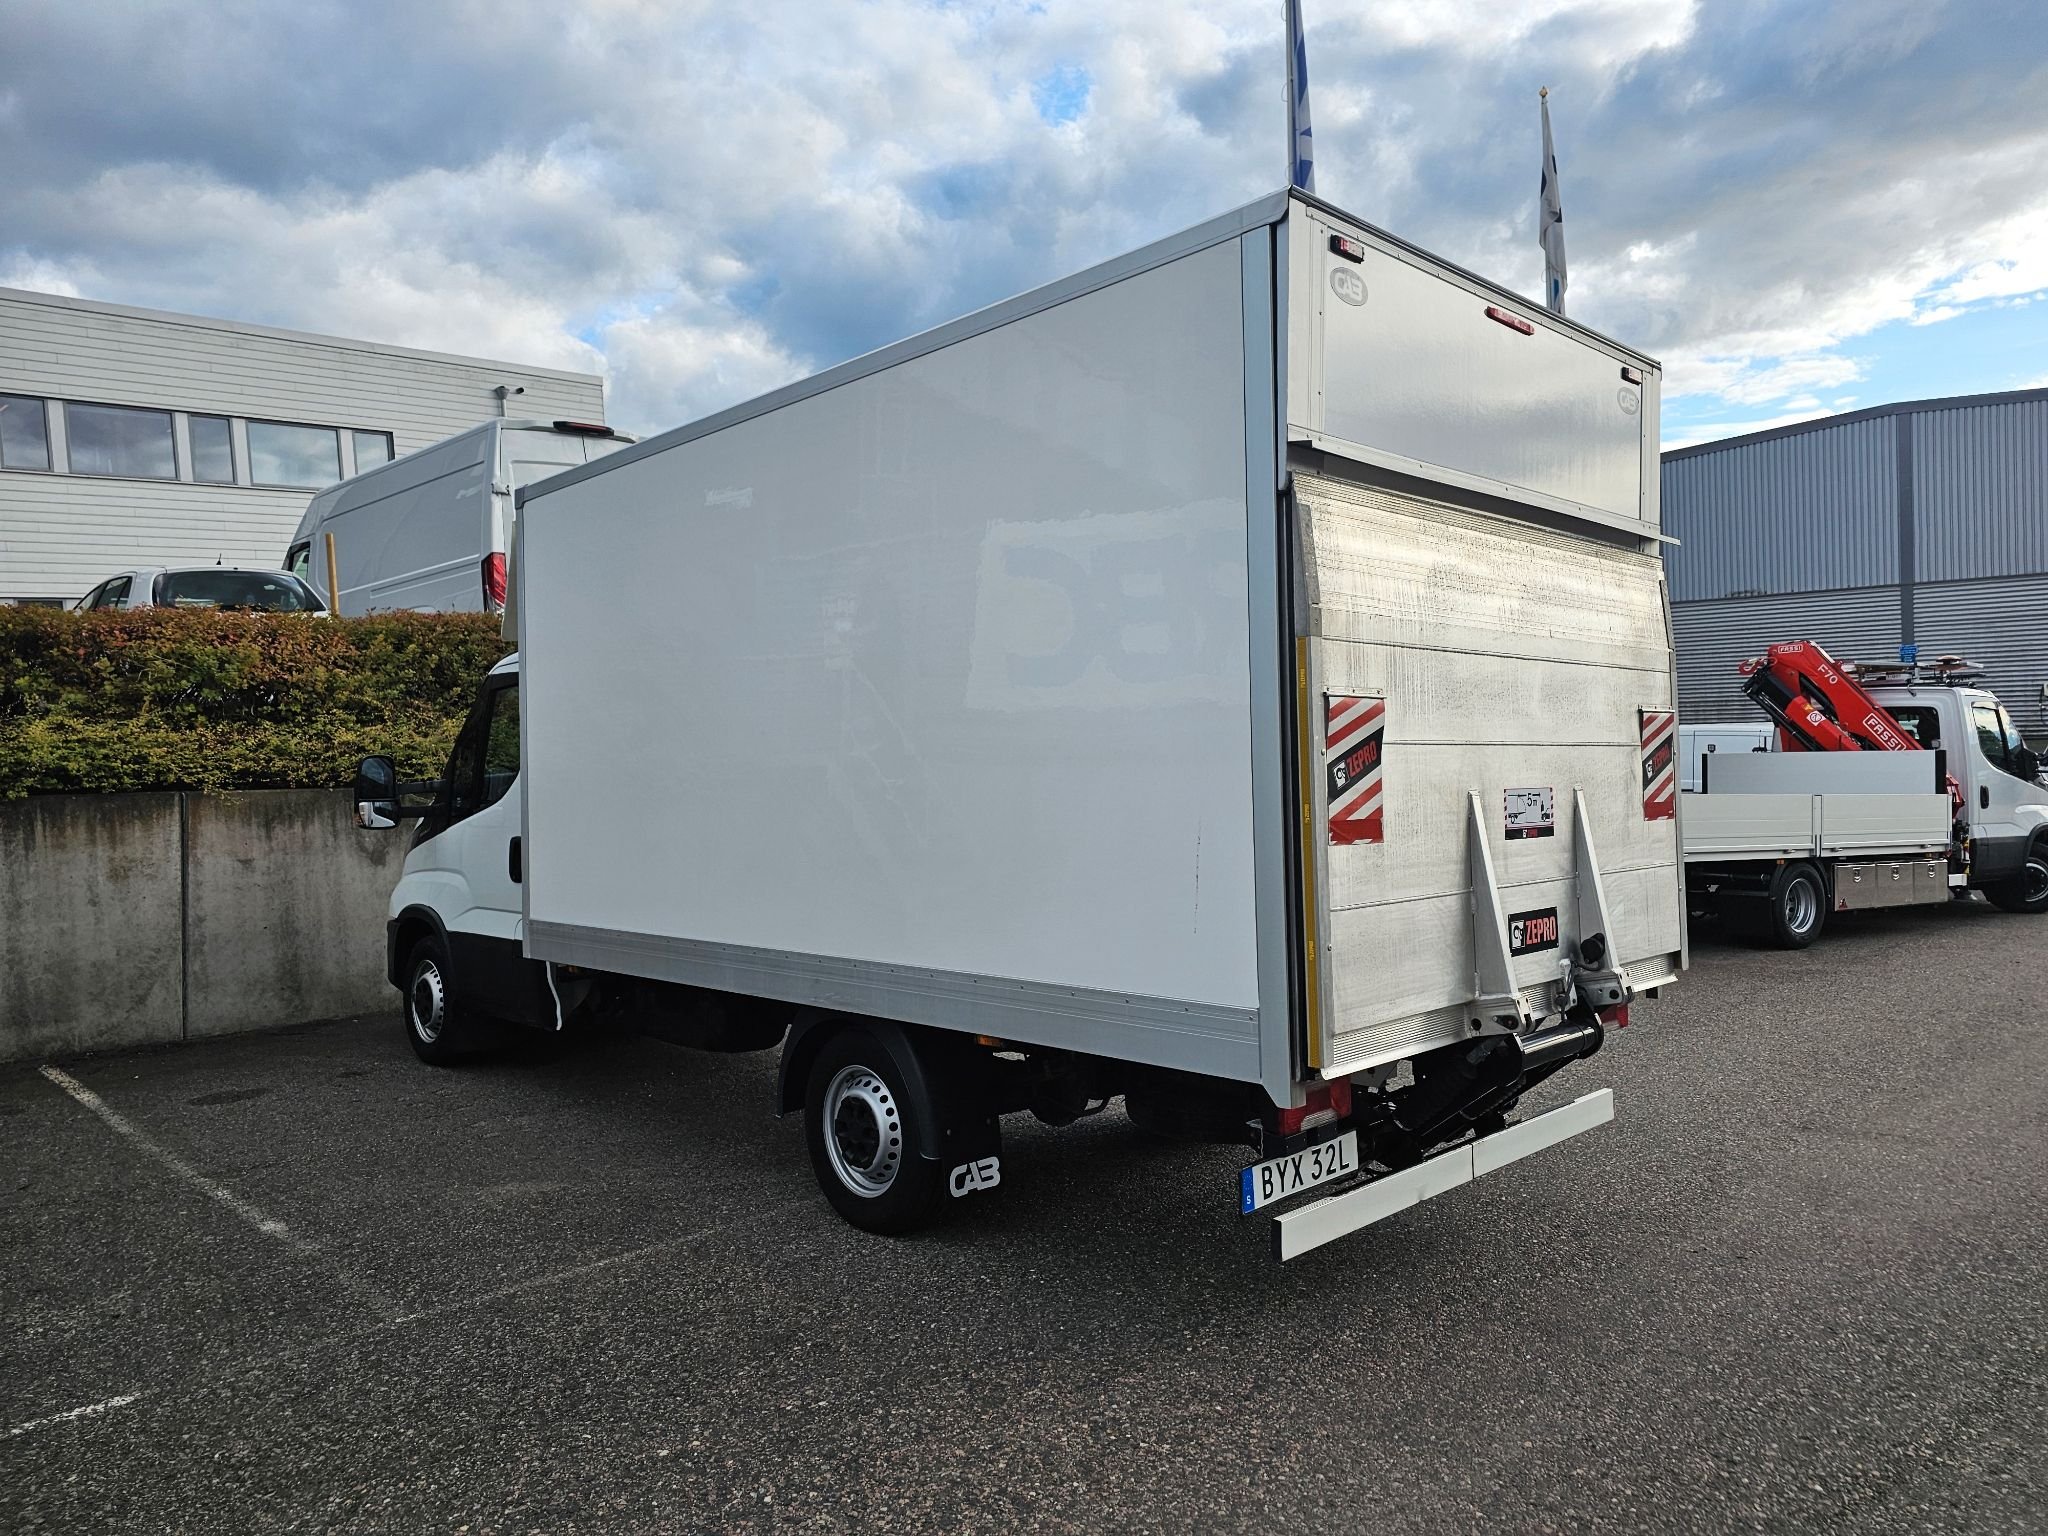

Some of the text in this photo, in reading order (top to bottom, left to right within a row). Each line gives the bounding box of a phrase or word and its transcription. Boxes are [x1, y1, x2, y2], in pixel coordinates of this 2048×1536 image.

[1817, 664, 1838, 684] F70
[1867, 718, 1902, 751] FASSI
[1346, 740, 1377, 778] ZEPRO
[1525, 916, 1557, 945] ZEPRO
[950, 1156, 1001, 1198] CAB
[1261, 1140, 1350, 1200] BYX 32L
[1246, 1195, 1252, 1204] S
